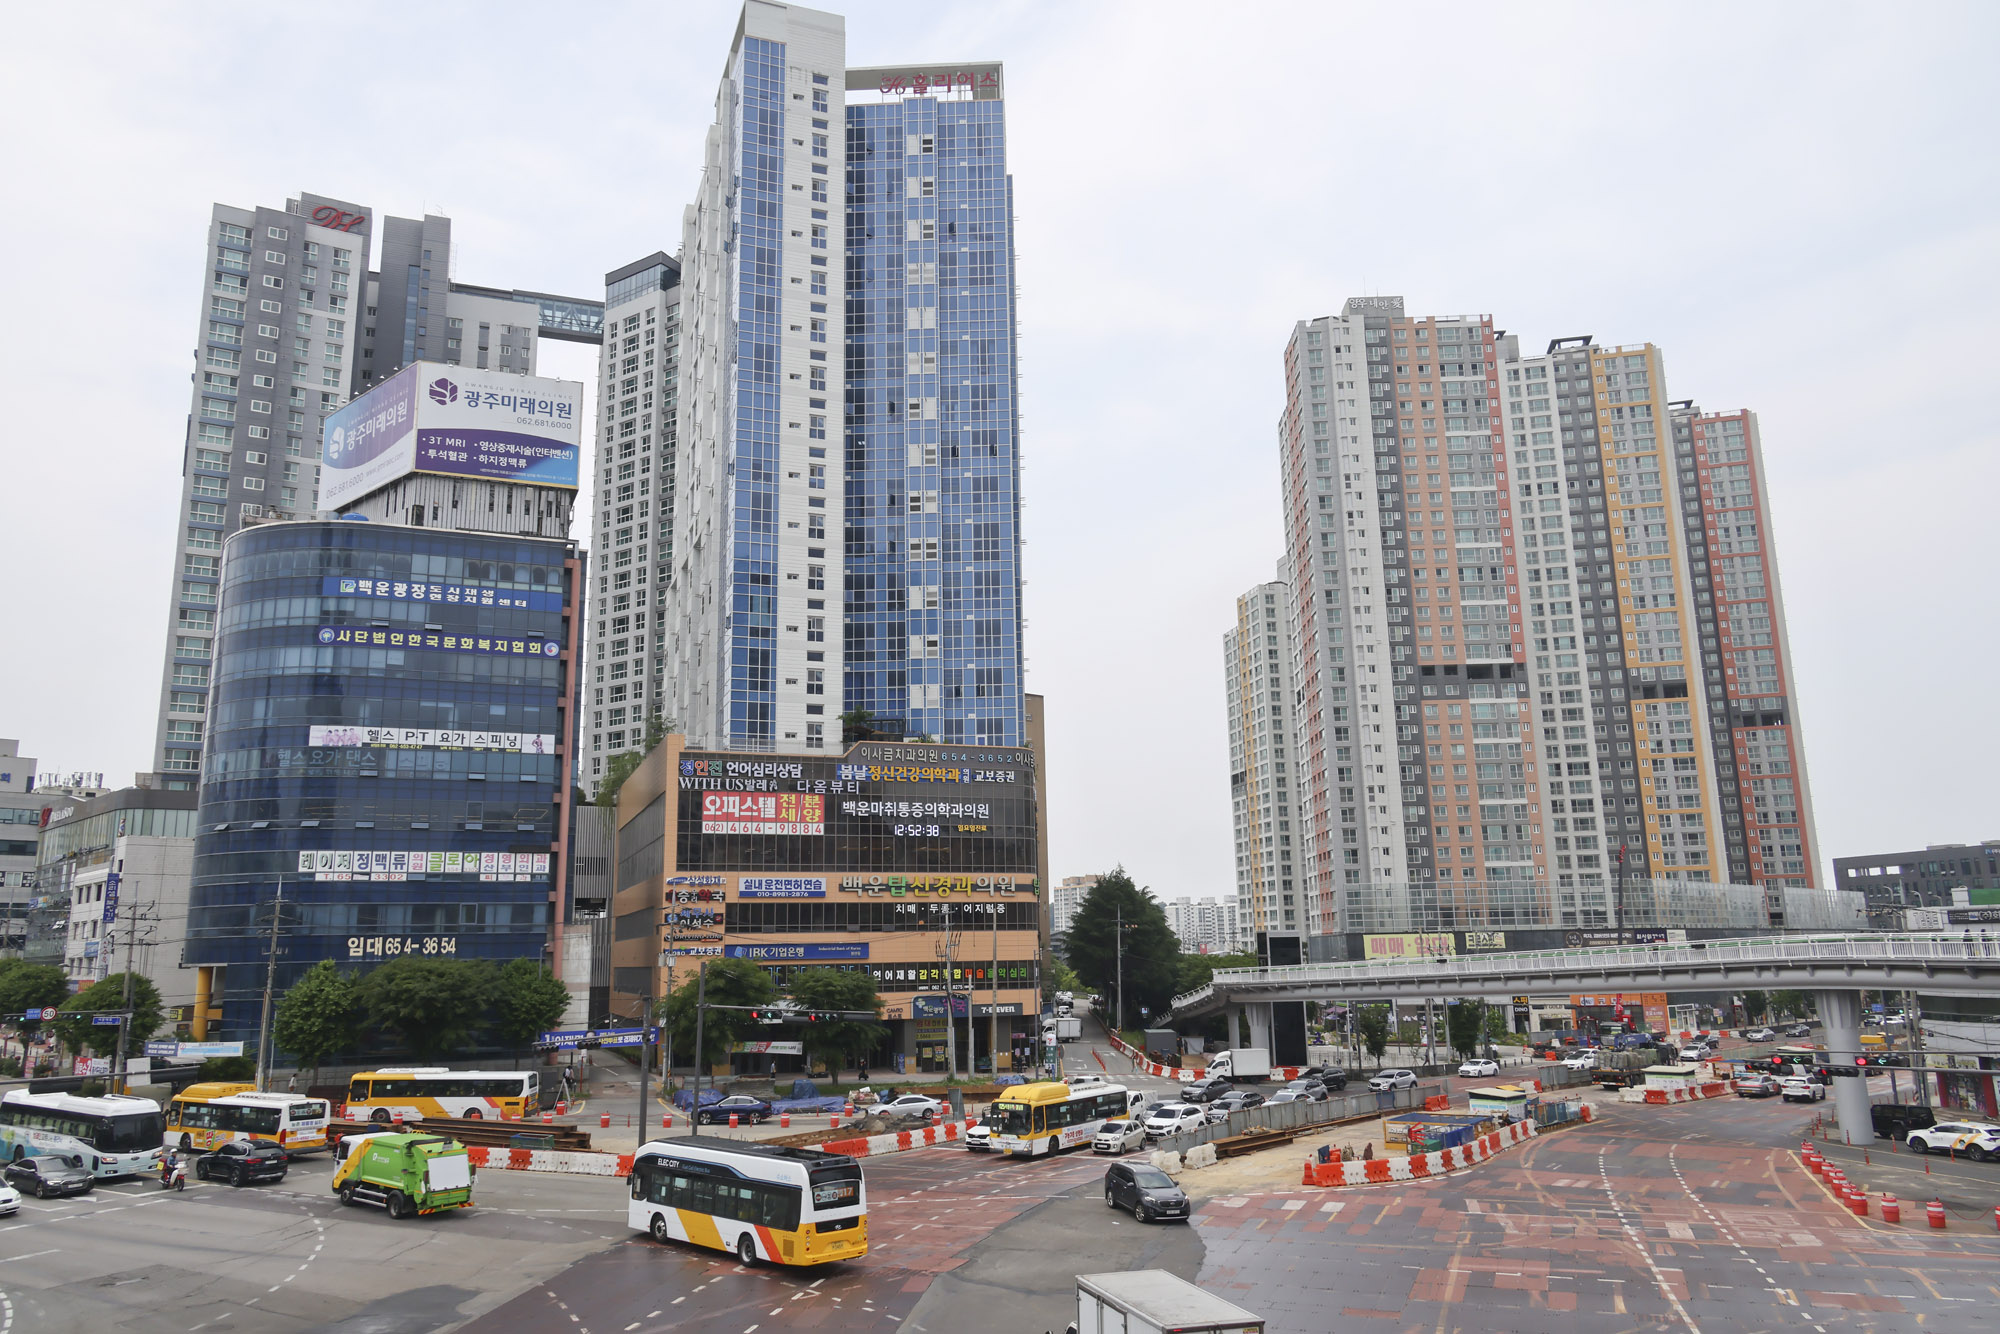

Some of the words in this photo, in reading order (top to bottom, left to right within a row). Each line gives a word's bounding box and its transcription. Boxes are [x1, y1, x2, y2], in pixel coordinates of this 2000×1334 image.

[912, 72, 998, 94] 홀리어스
[1349, 298, 1367, 309] 양우
[464, 390, 572, 420] 광주미래의원
[346, 398, 408, 451] 광주미래의원
[516, 416, 572, 430] 062.681.6000
[428, 436, 443, 445] 3T
[446, 437, 466, 448] MRI
[427, 448, 468, 463] 투석혈관
[479, 440, 574, 460] 영상중재시술(인터벤션)
[478, 454, 528, 469] 하지정맥류
[358, 579, 426, 599] 백운광장
[429, 586, 494, 597] 도시재생
[429, 594, 527, 608] 현장지원센터
[367, 729, 395, 742] 헬스
[439, 732, 466, 745] 요가
[474, 734, 517, 747] 스피닝
[309, 750, 339, 766] 요가
[861, 746, 938, 763] 이사금치과의원
[941, 752, 1013, 763] 654-3652
[726, 761, 802, 778] 언어심리상담
[839, 764, 867, 781] 봄날
[868, 766, 961, 783] 정신건강의학과
[962, 768, 970, 784] 의원
[974, 770, 1015, 783] 교보증권
[679, 777, 722, 790] WITH
[797, 779, 860, 795] 다옴뷰티
[703, 796, 776, 819] 오피스텔
[779, 794, 796, 822] 전세
[802, 794, 821, 823] 분양
[842, 801, 989, 819] 백운마취통증의학과의원
[704, 823, 724, 833] 062)
[729, 823, 822, 834] 464-9884
[894, 824, 940, 837] 12:52:38
[301, 853, 351, 870] 레이저
[357, 853, 406, 870] 정맥류
[428, 853, 479, 871] 클로아
[688, 875, 721, 887] 삼성화재
[743, 878, 762, 891] 실내
[765, 878, 803, 891] 운전면허
[804, 878, 823, 891] 연습
[842, 875, 1016, 897] 백운탑신경과의원
[896, 904, 916, 914] 치매
[963, 903, 1006, 914] 어지럼증
[347, 936, 383, 957] 임대
[689, 946, 722, 956] 교보증권
[749, 947, 768, 958] IBK
[770, 947, 804, 957] 기업은행
[1371, 937, 1405, 955] 매매
[873, 970, 917, 980] 언어재활
[44, 1010, 54, 1018] 50
[658, 1158, 669, 1167] ELEC
[669, 1160, 680, 1168] CITY
